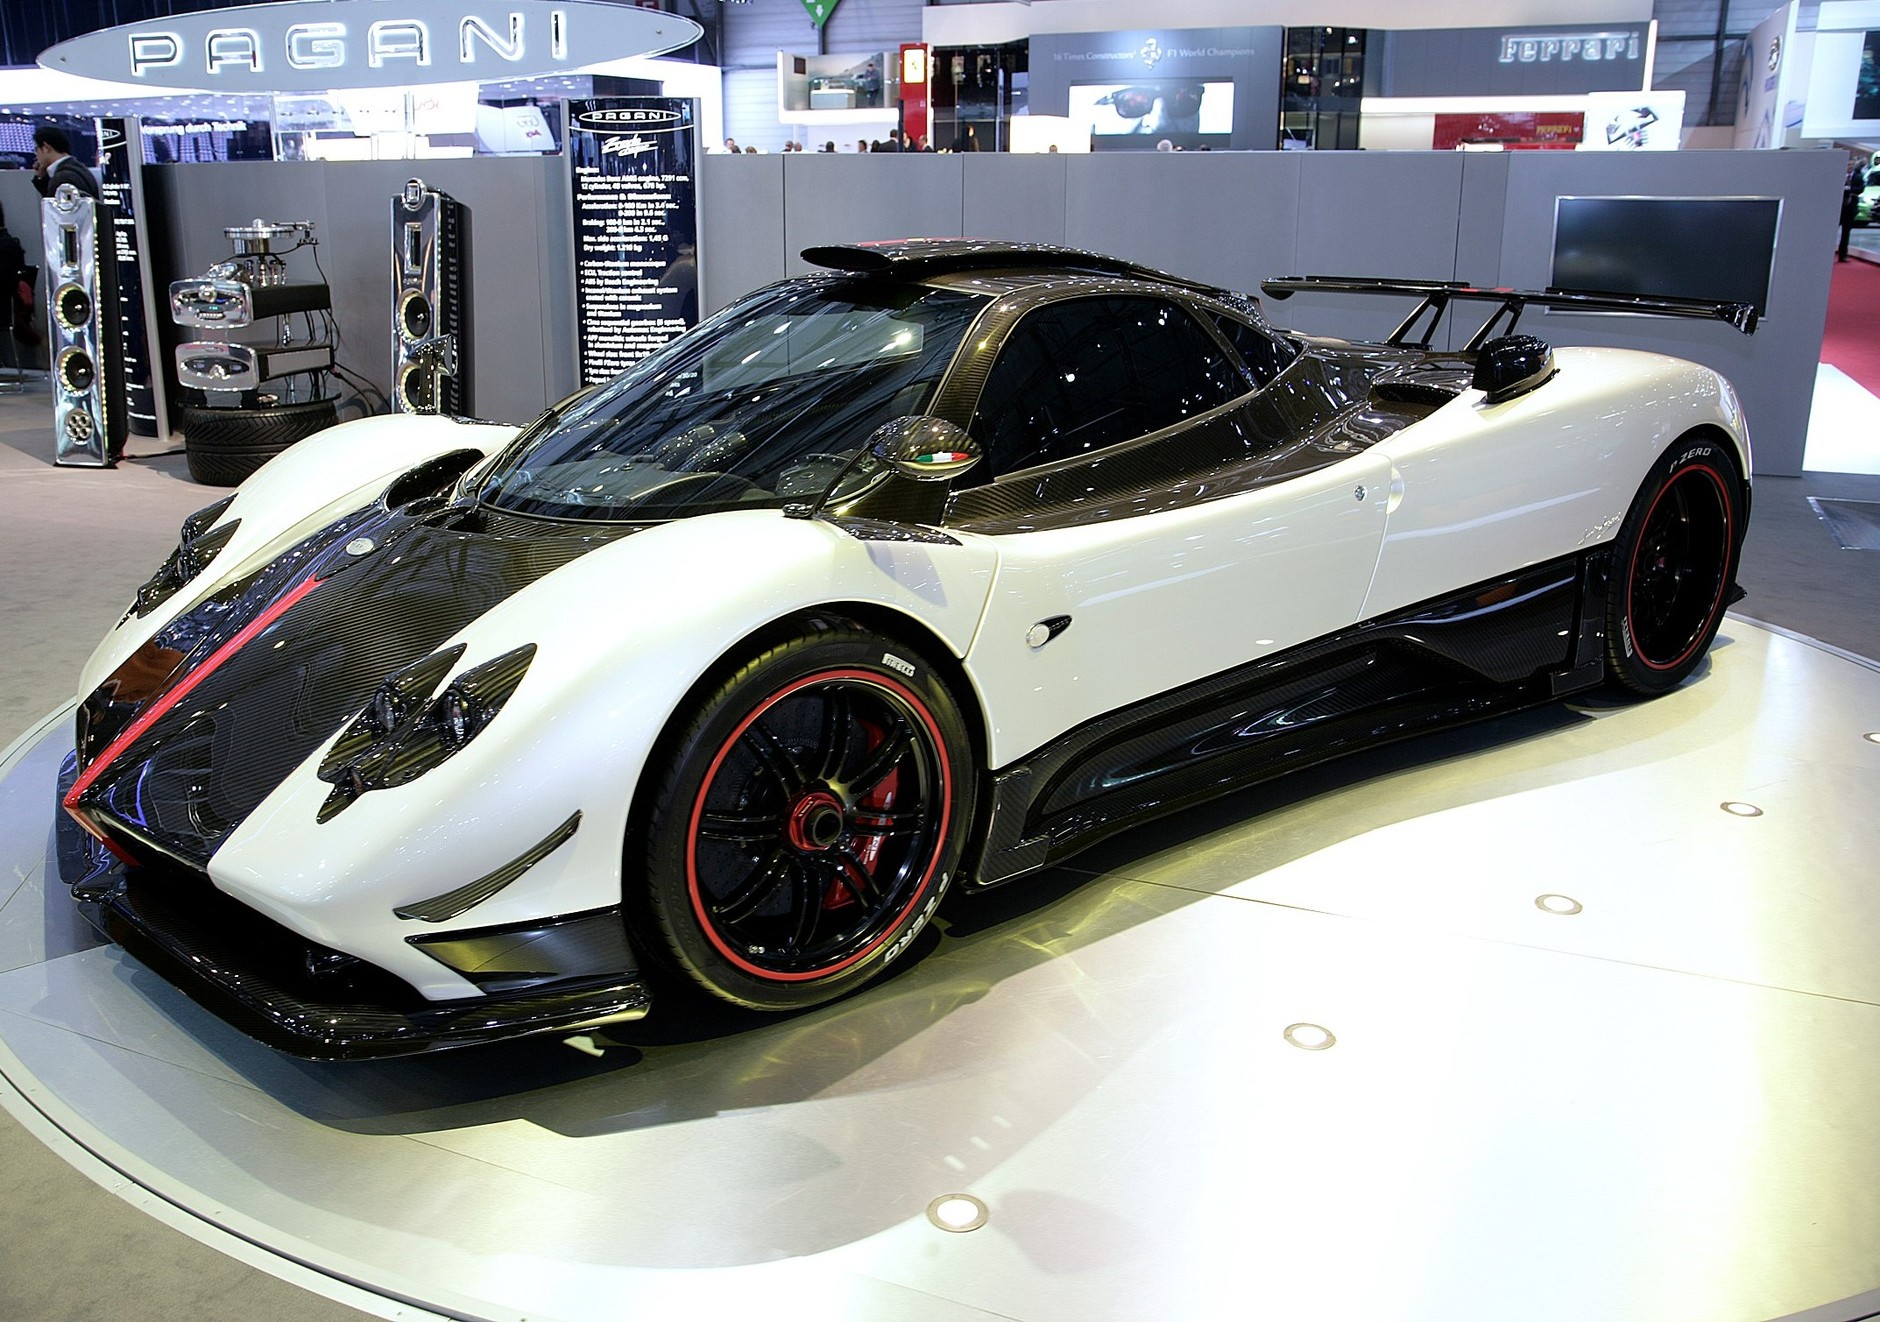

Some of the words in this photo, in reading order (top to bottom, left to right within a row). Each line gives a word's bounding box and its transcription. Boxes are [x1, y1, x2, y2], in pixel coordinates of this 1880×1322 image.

[128, 11, 567, 76] PAGANI
[1167, 48, 1177, 57] F1
[1179, 47, 1205, 57] World
[1207, 46, 1255, 58] Champions
[1499, 31, 1640, 62] Ferrari
[142, 124, 184, 135] Vorsprung
[185, 122, 212, 132] durch
[212, 120, 248, 131] Technik
[591, 112, 667, 120] PAGANI
[1669, 460, 1677, 473] P
[1679, 447, 1712, 464] ZERO
[881, 653, 916, 677] PIRELLI
[939, 872, 949, 893] P
[884, 896, 937, 963] ZERO
